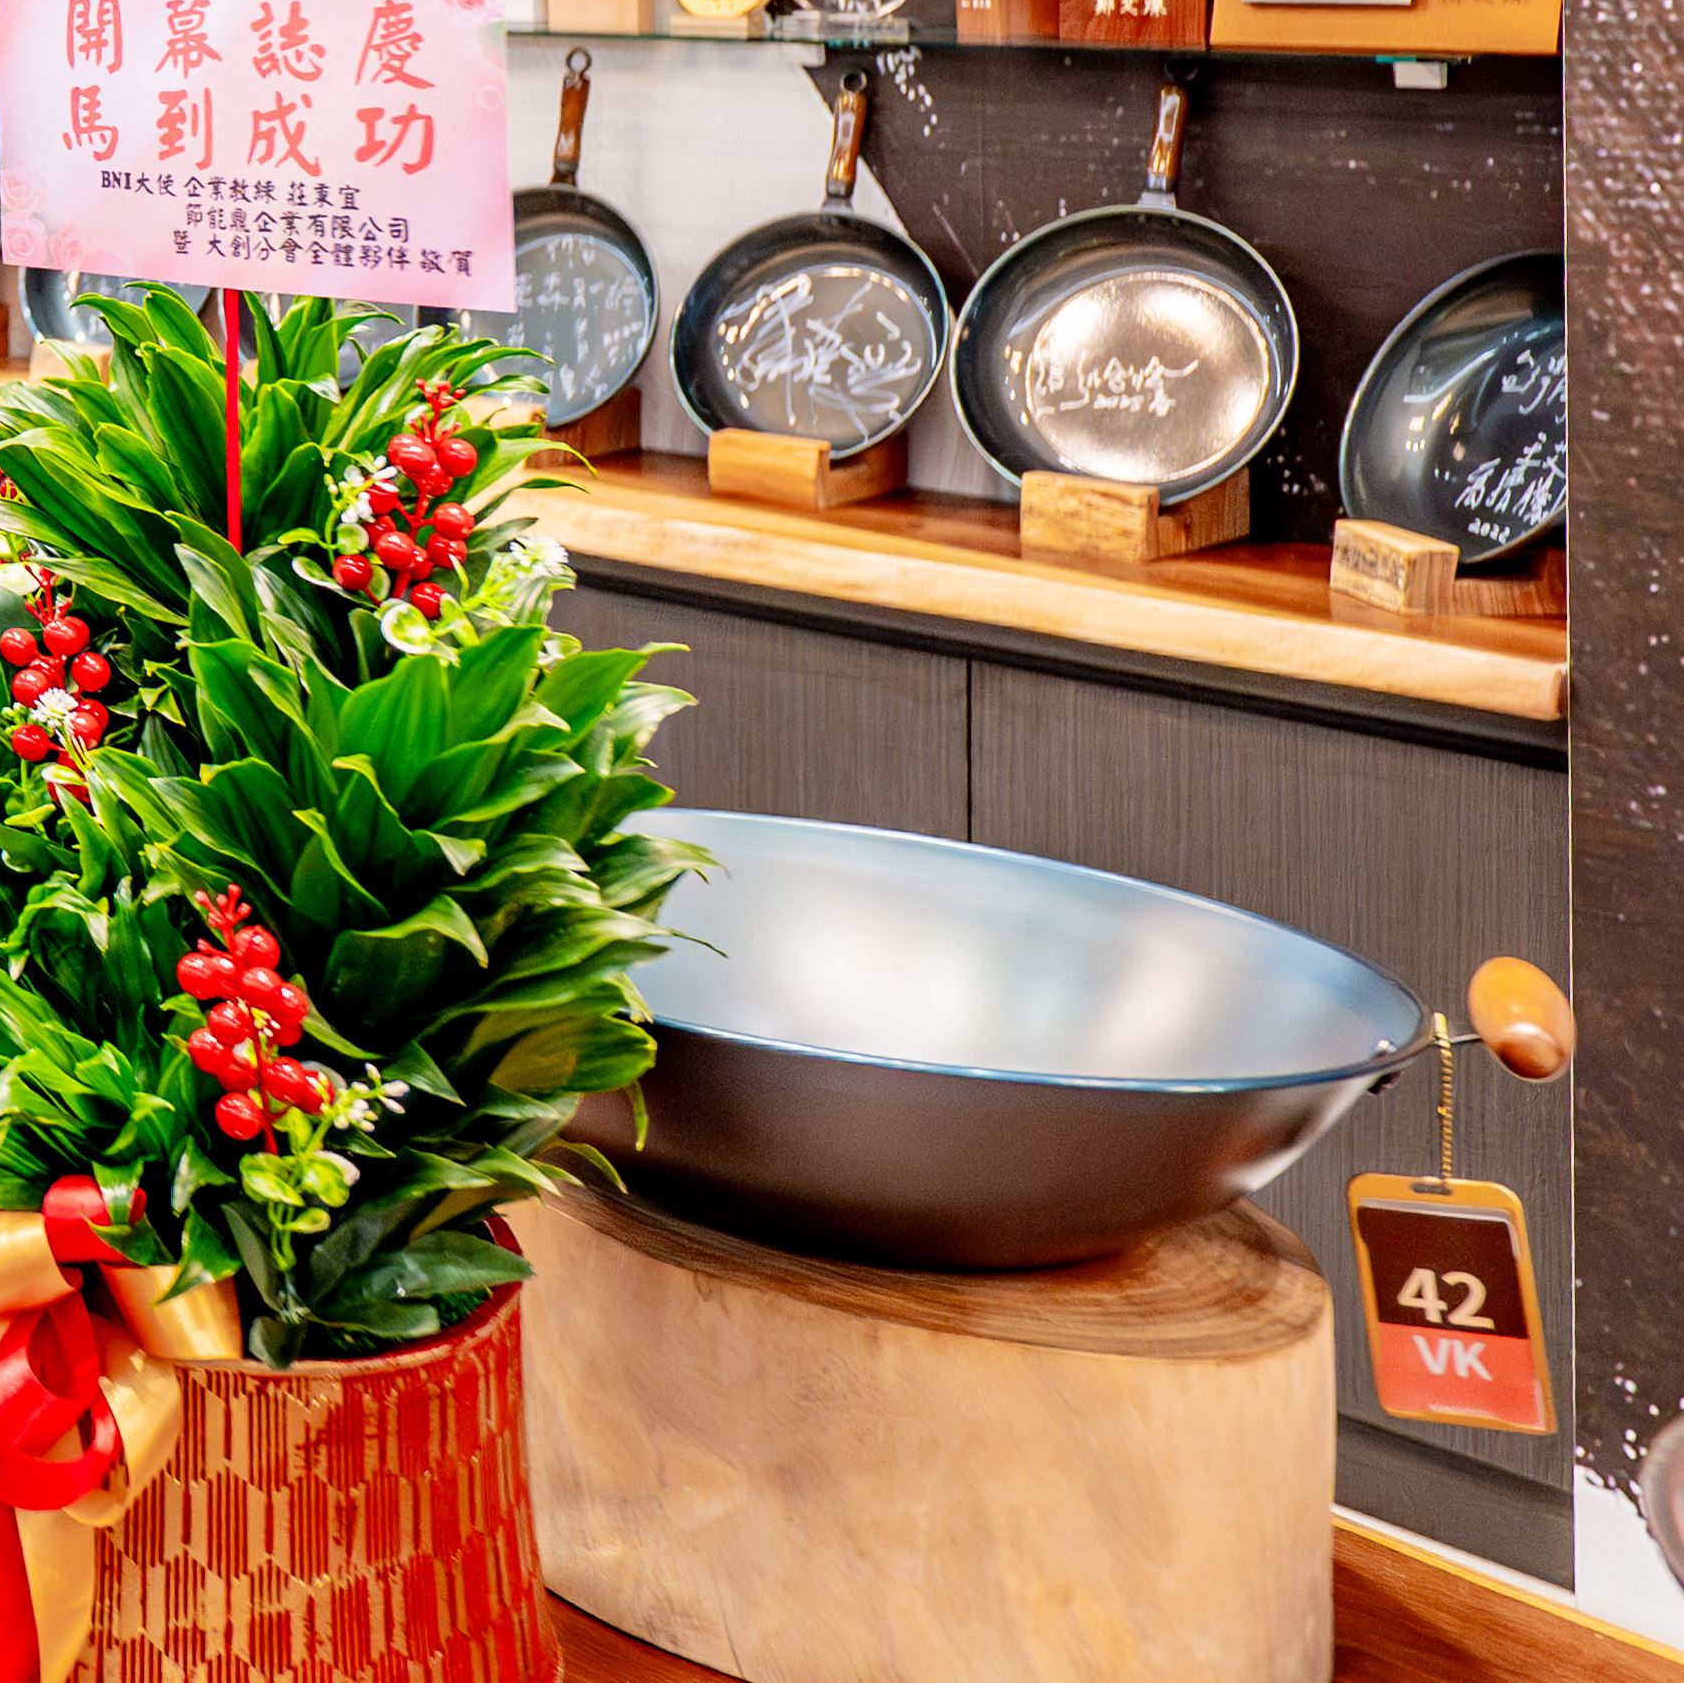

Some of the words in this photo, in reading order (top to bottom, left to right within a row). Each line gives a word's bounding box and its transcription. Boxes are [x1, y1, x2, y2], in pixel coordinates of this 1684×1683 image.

[63, 86, 435, 177] 馬到成功
[100, 170, 177, 197] BNI大使
[183, 176, 277, 204] 企業教練
[1396, 1267, 1495, 1331] 42
[1411, 1334, 1493, 1381] VK
